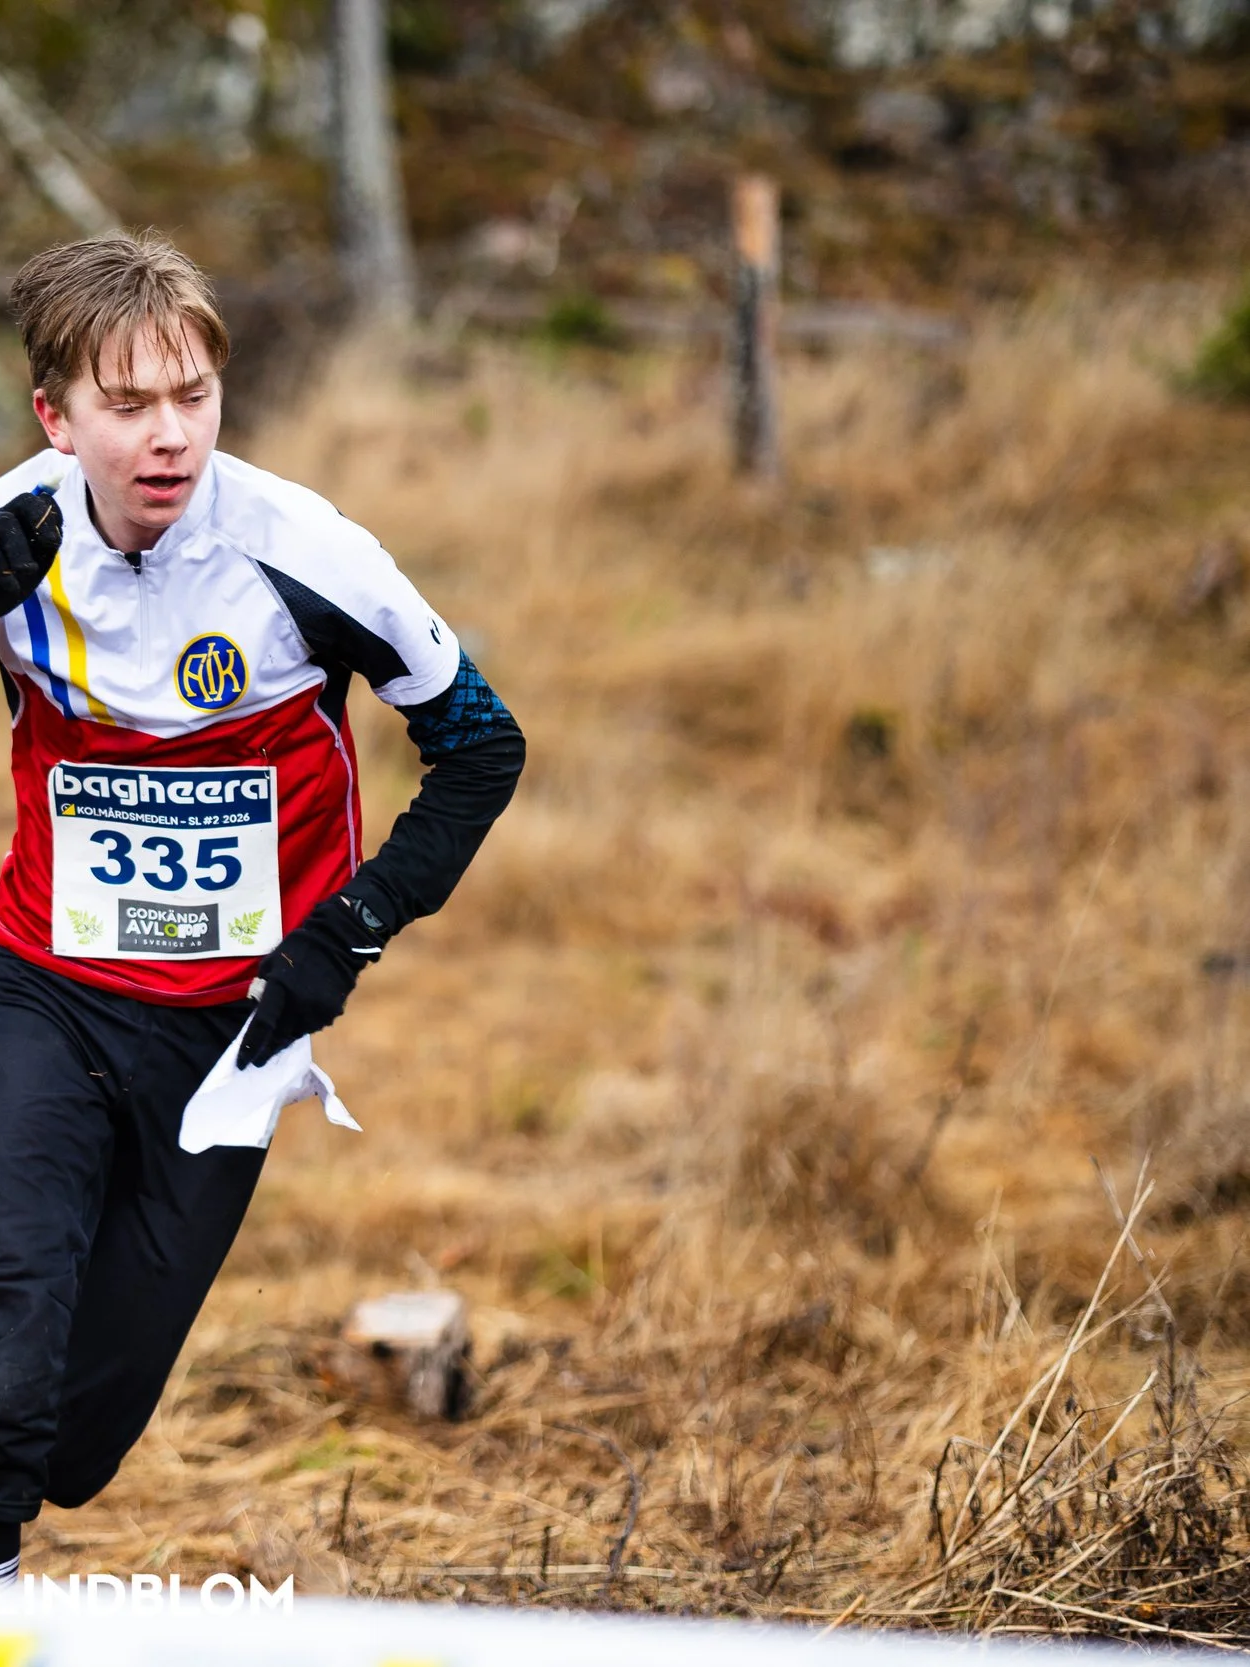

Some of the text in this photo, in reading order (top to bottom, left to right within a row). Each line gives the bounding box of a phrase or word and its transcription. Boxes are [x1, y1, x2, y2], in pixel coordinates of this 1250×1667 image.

[183, 642, 241, 702] AIK
[56, 767, 268, 806] bagheera
[77, 806, 179, 826] KOLMÅRDSMEDELN
[188, 817, 201, 826] SL
[203, 815, 219, 825] #2
[223, 812, 250, 823] 2026
[90, 829, 242, 891] 335
[126, 907, 209, 923] GODKÄNDA
[143, 939, 185, 948] SVERIGE
